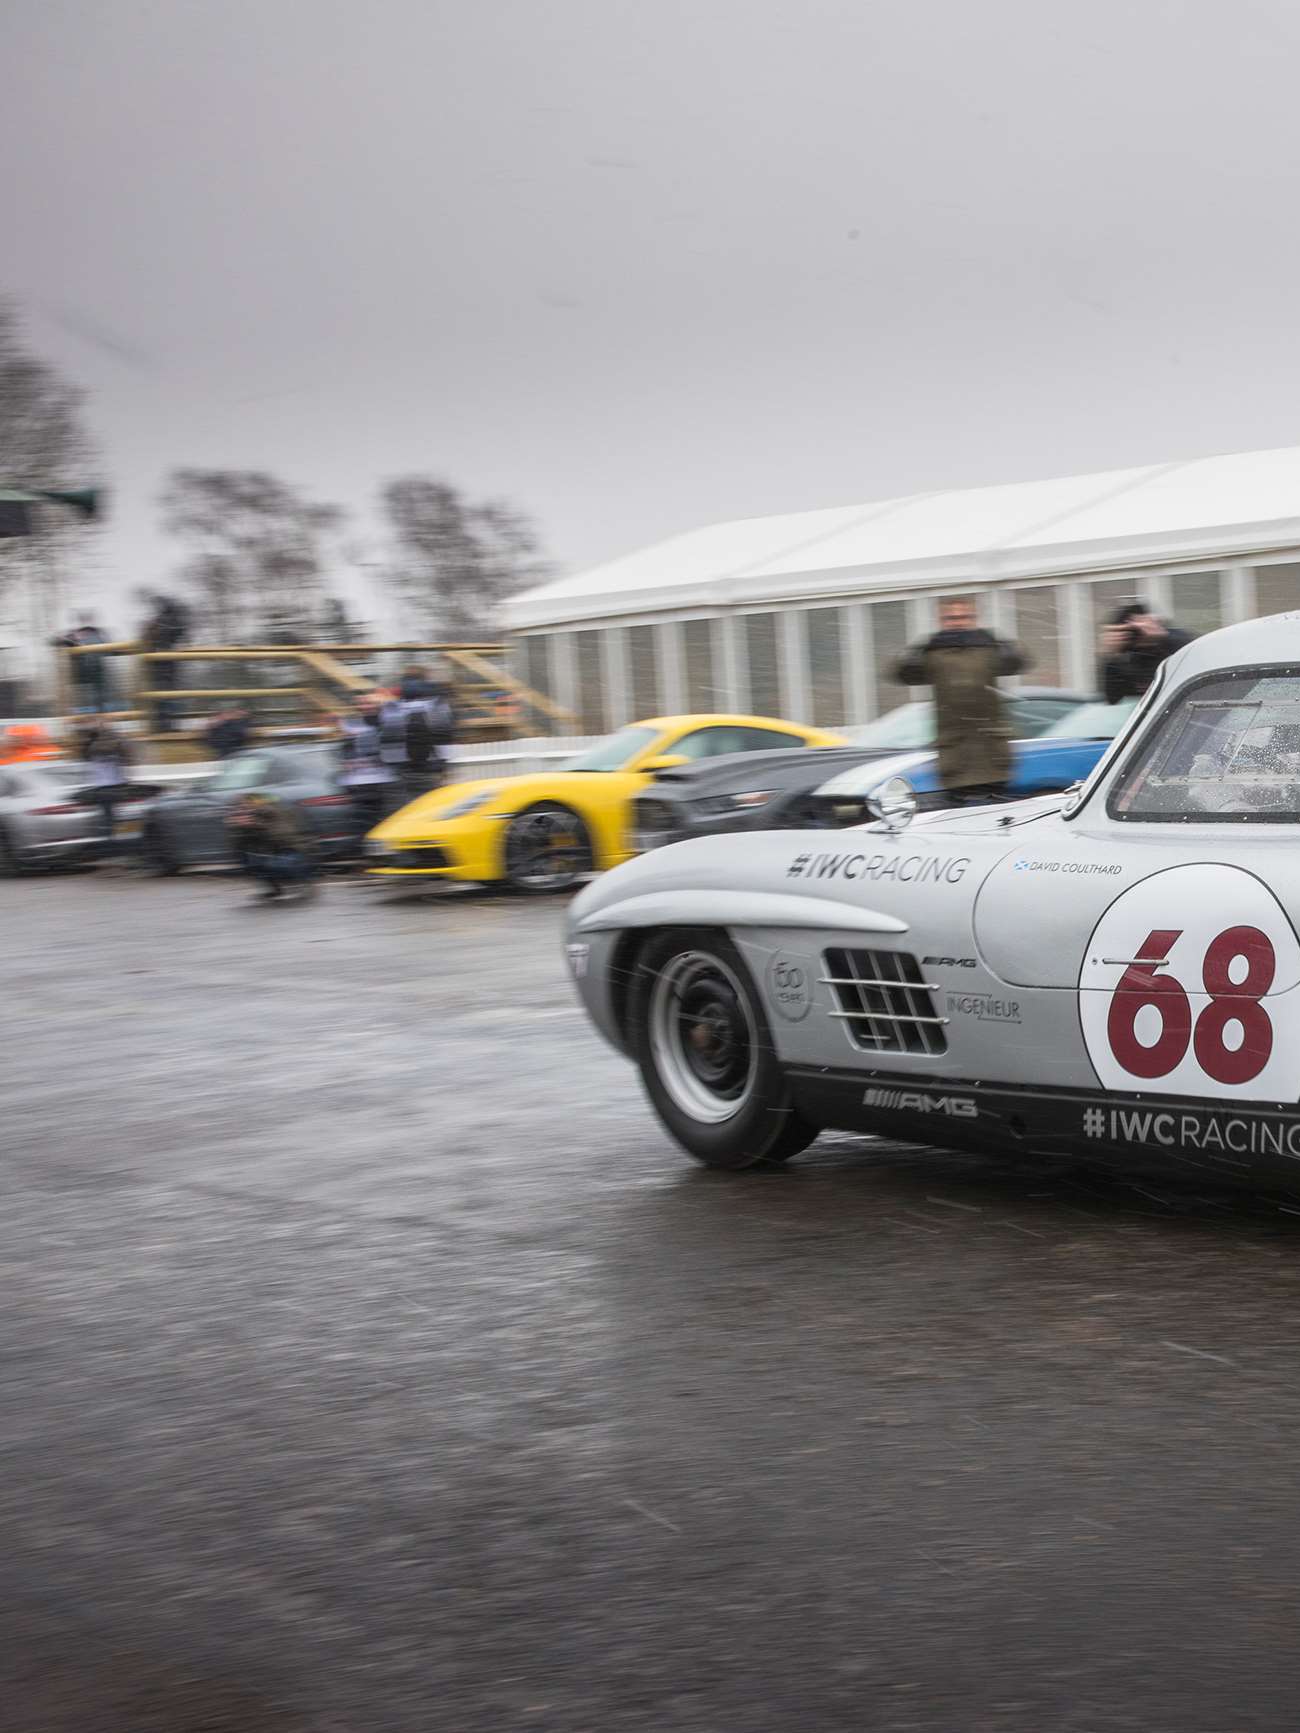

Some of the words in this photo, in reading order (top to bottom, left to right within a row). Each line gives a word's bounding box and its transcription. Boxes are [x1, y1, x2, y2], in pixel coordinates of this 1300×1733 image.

[786, 853, 971, 884] #IWCRACING
[1029, 862, 1060, 872] DAVID
[1062, 863, 1123, 876] COULTHARD
[945, 997, 1021, 1018] INGENIEUR
[1107, 925, 1276, 1085] 68
